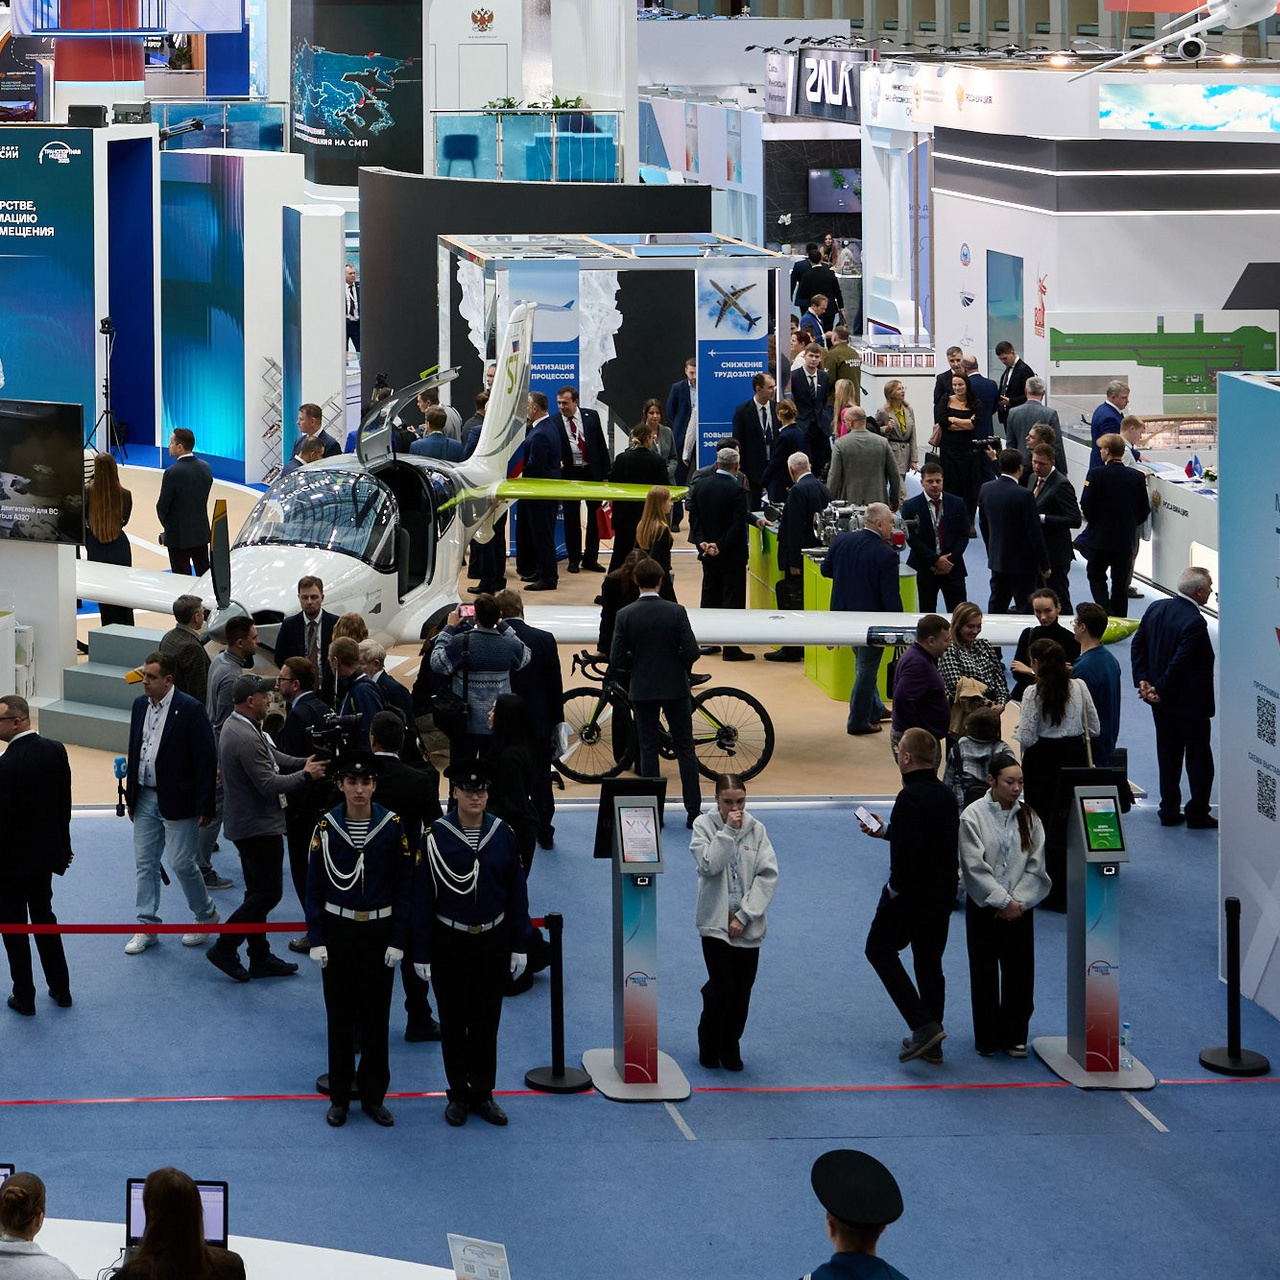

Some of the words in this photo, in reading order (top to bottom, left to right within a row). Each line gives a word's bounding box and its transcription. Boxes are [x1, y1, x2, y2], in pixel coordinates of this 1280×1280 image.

[335, 139, 346, 147] НА
[348, 139, 369, 147] СМП
[530, 363, 575, 371] МАТИЗАЦИЯ
[721, 361, 763, 369] СНИЖЕНИЕ
[531, 373, 575, 381] ПРОЦЕССОВ
[49, 507, 59, 515] ВС
